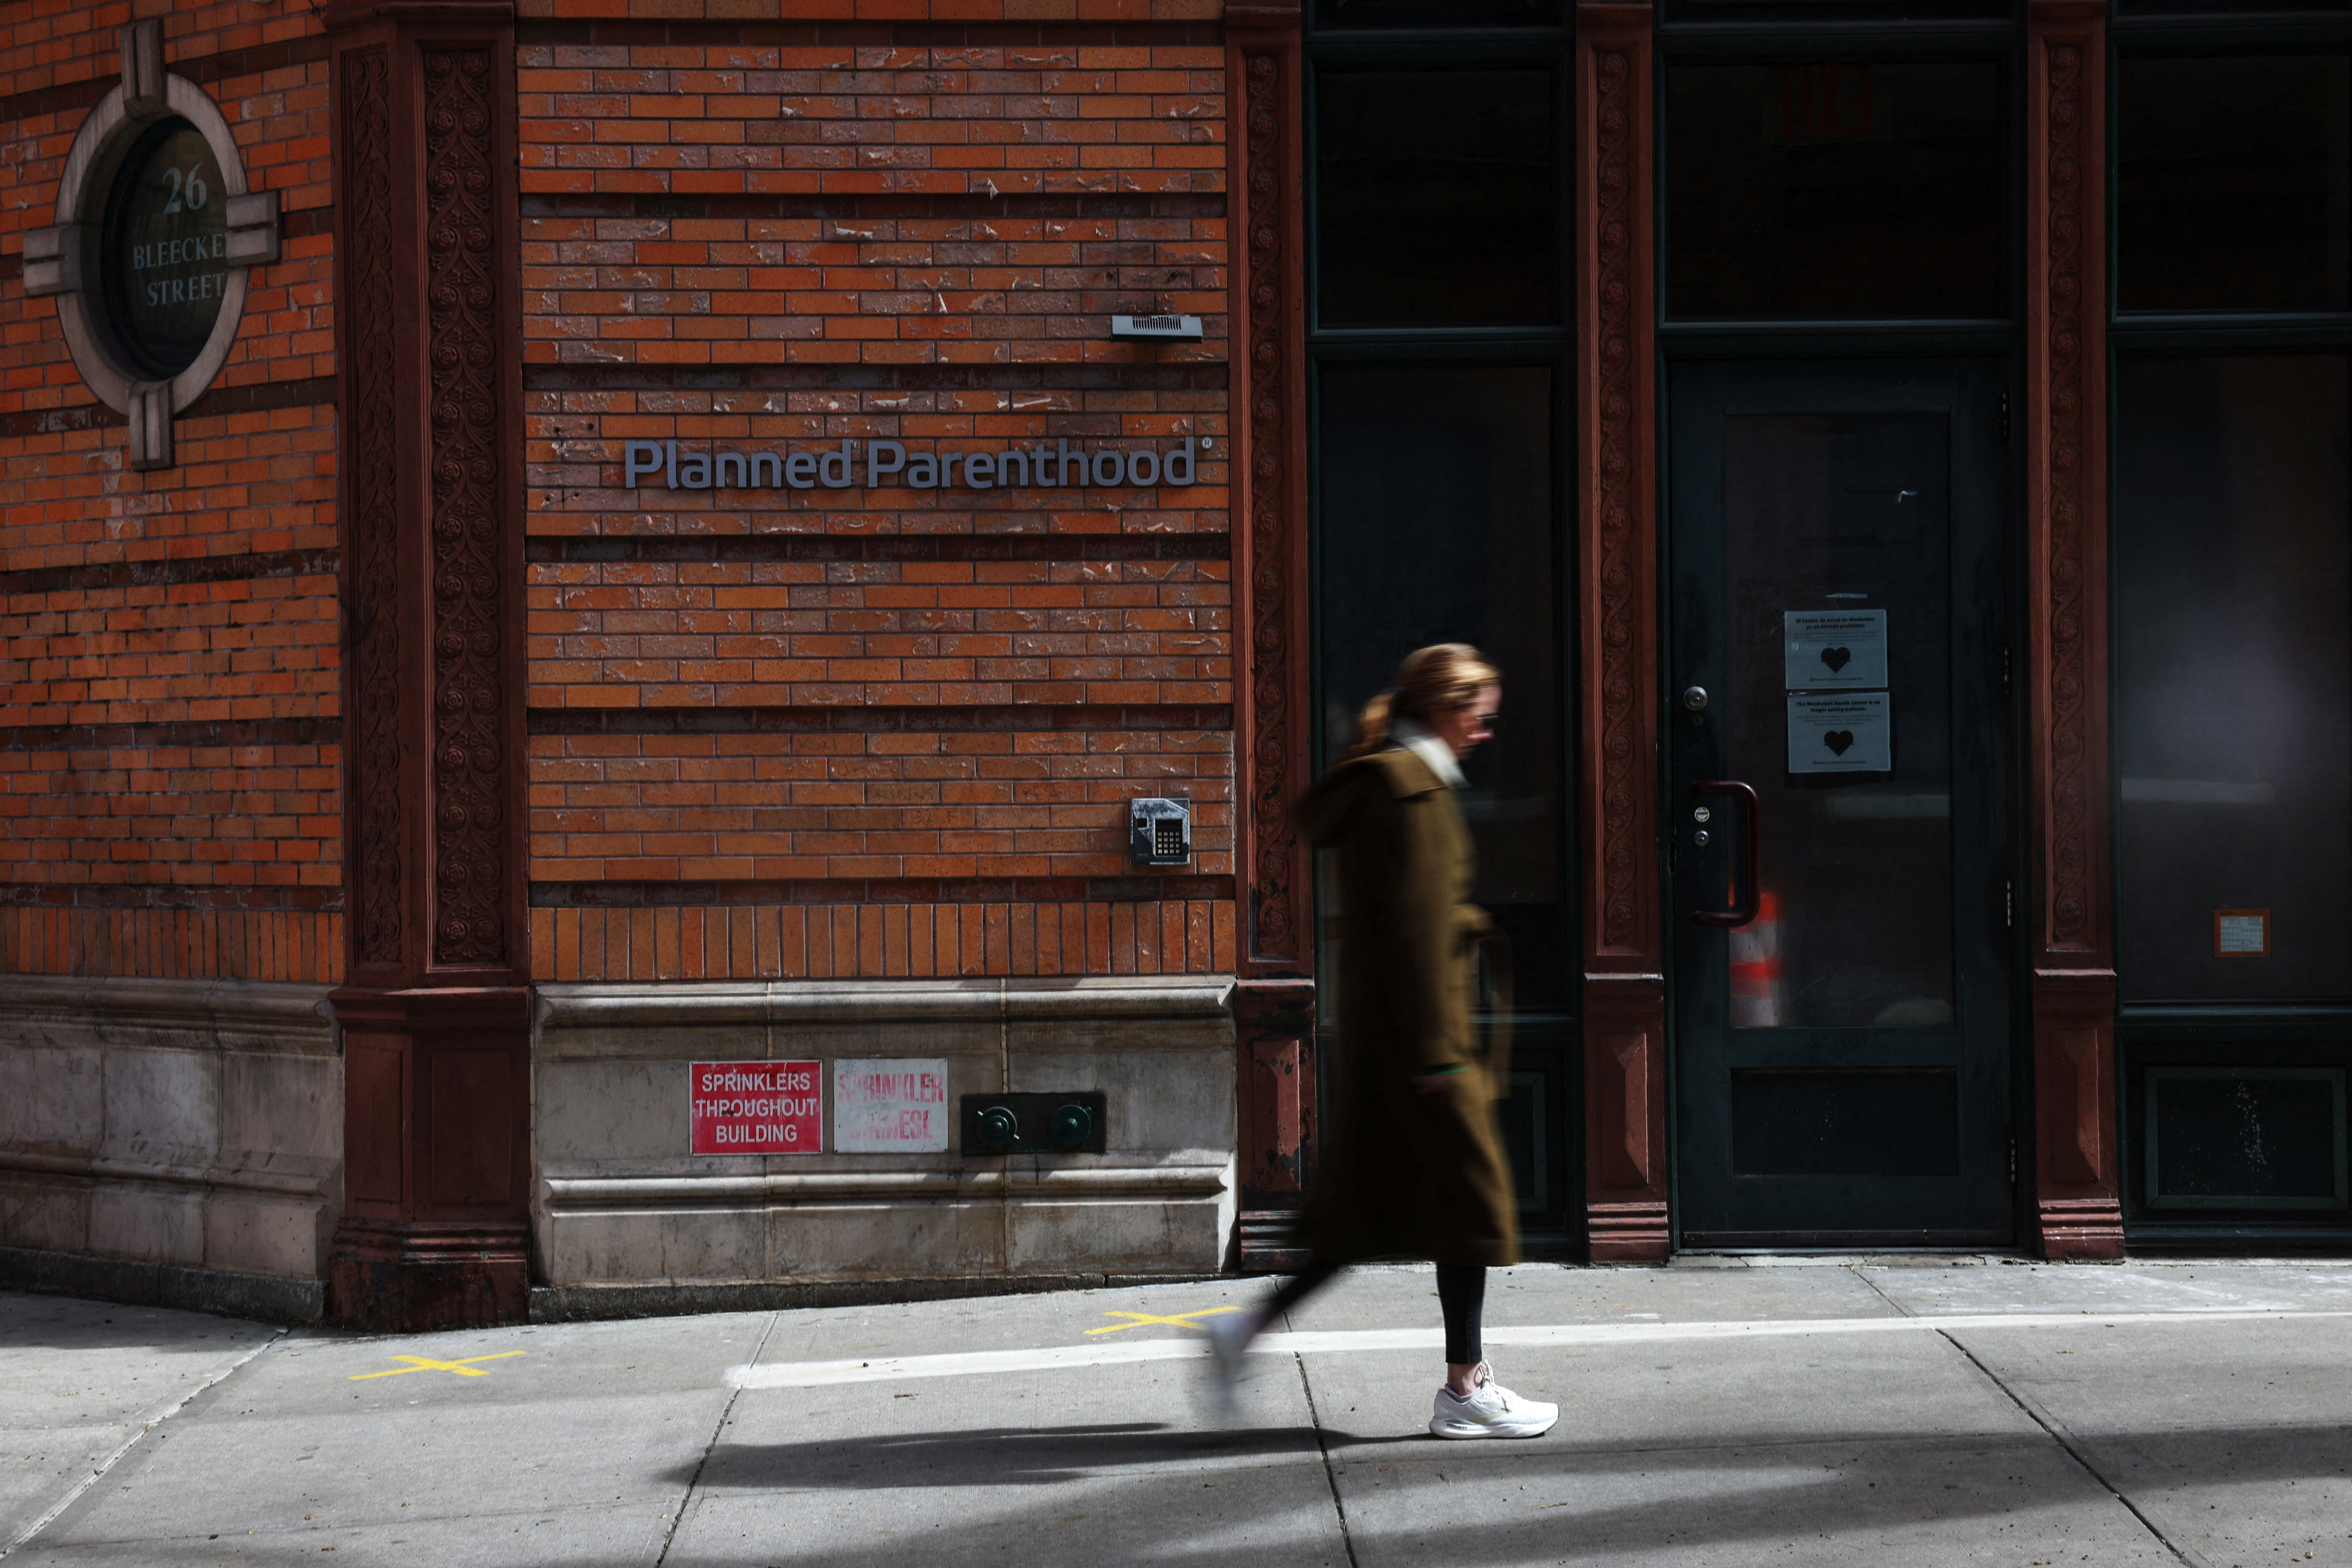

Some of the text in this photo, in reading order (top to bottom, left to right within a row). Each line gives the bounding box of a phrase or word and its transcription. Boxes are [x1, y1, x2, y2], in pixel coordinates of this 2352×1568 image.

[163, 162, 206, 214] 26
[147, 273, 225, 306] STREET
[625, 438, 853, 489] Planned
[702, 1072, 811, 1092] SPRINKLERS
[696, 1098, 817, 1118] THROUGHOUT
[716, 1124, 797, 1143] BUILDING
